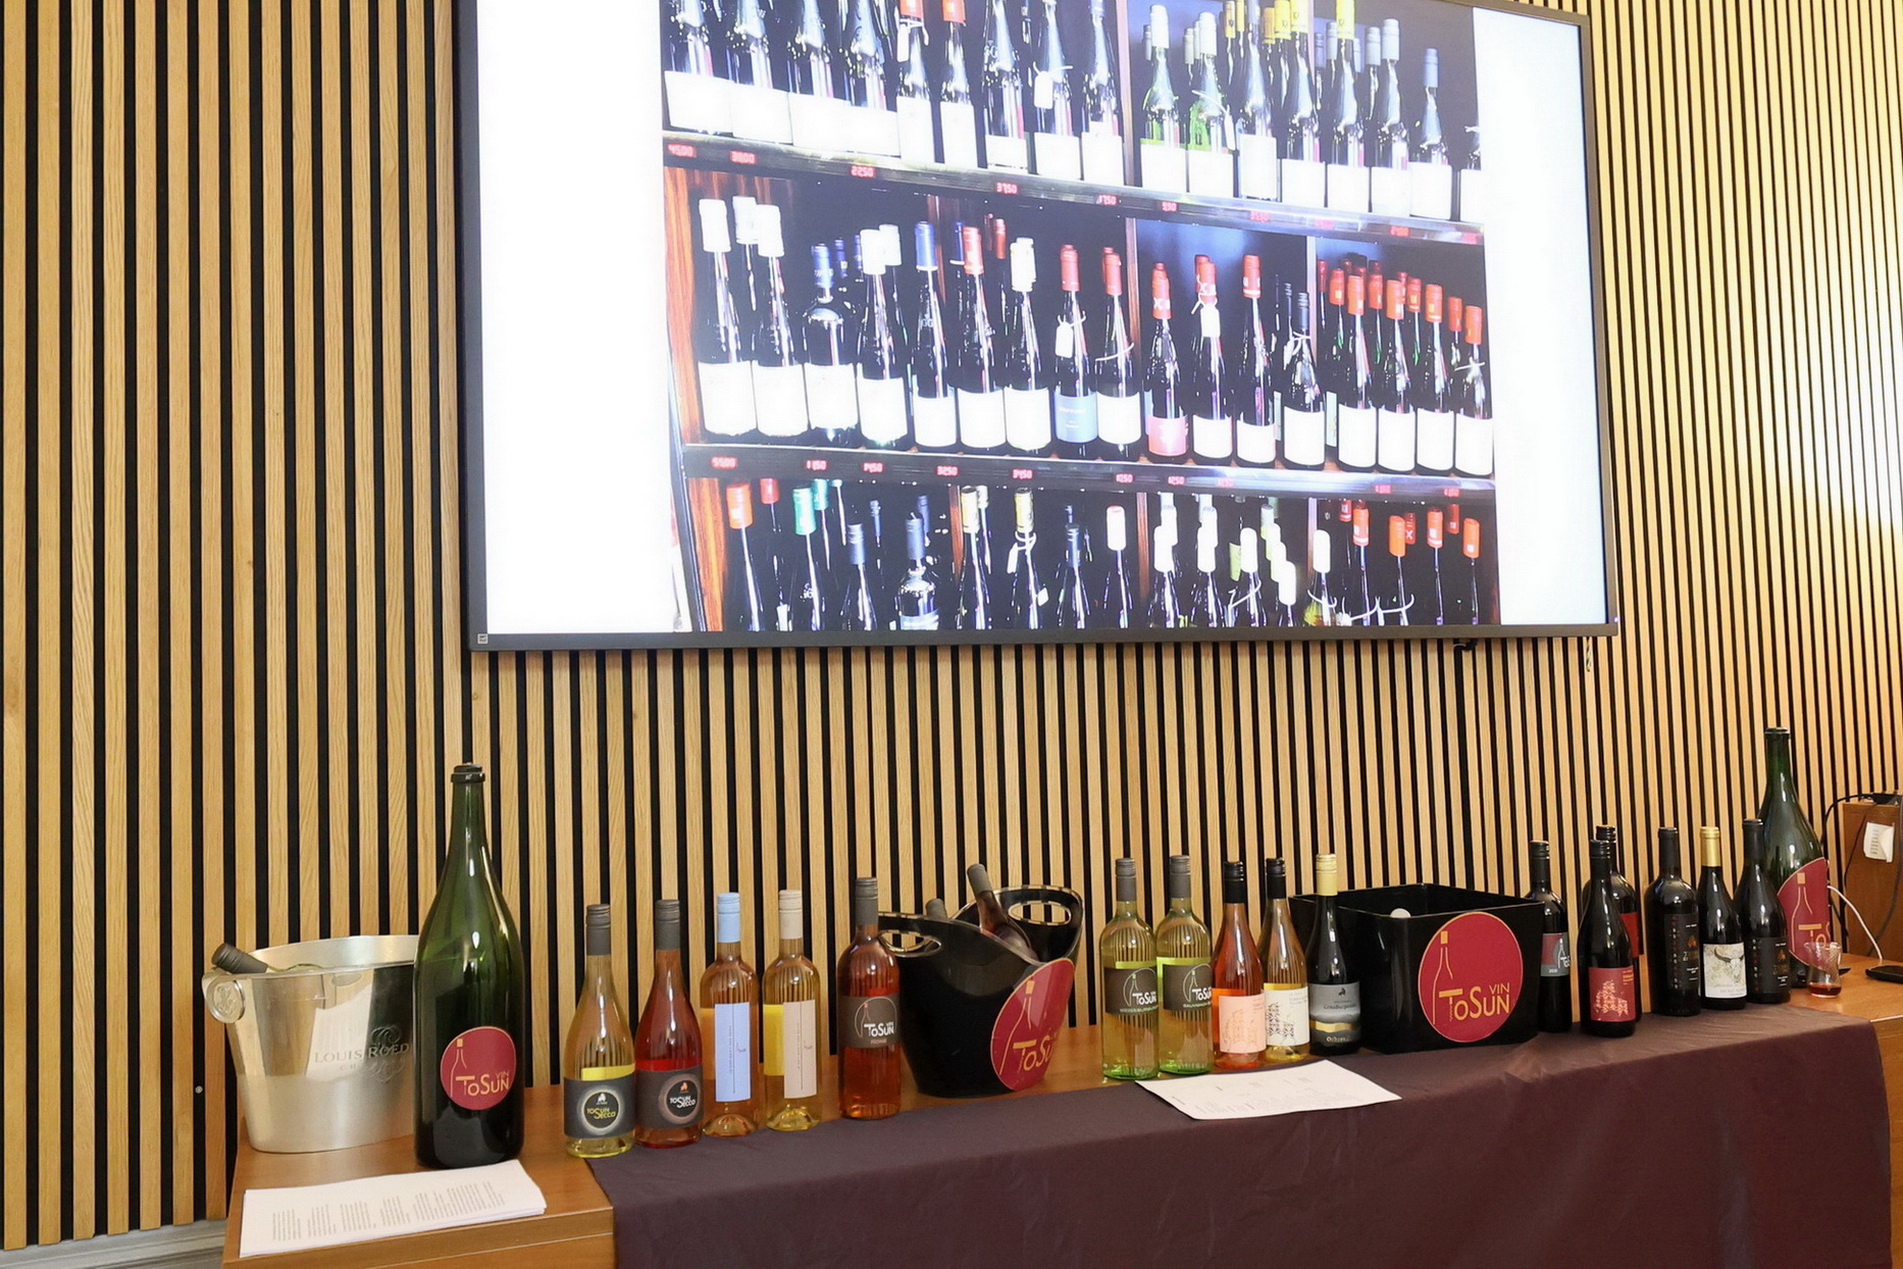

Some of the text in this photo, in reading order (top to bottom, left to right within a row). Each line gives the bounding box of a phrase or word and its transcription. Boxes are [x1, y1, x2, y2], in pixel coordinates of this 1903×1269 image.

[1489, 982, 1510, 995] VIN
[314, 1043, 410, 1063] LOUIS ROED
